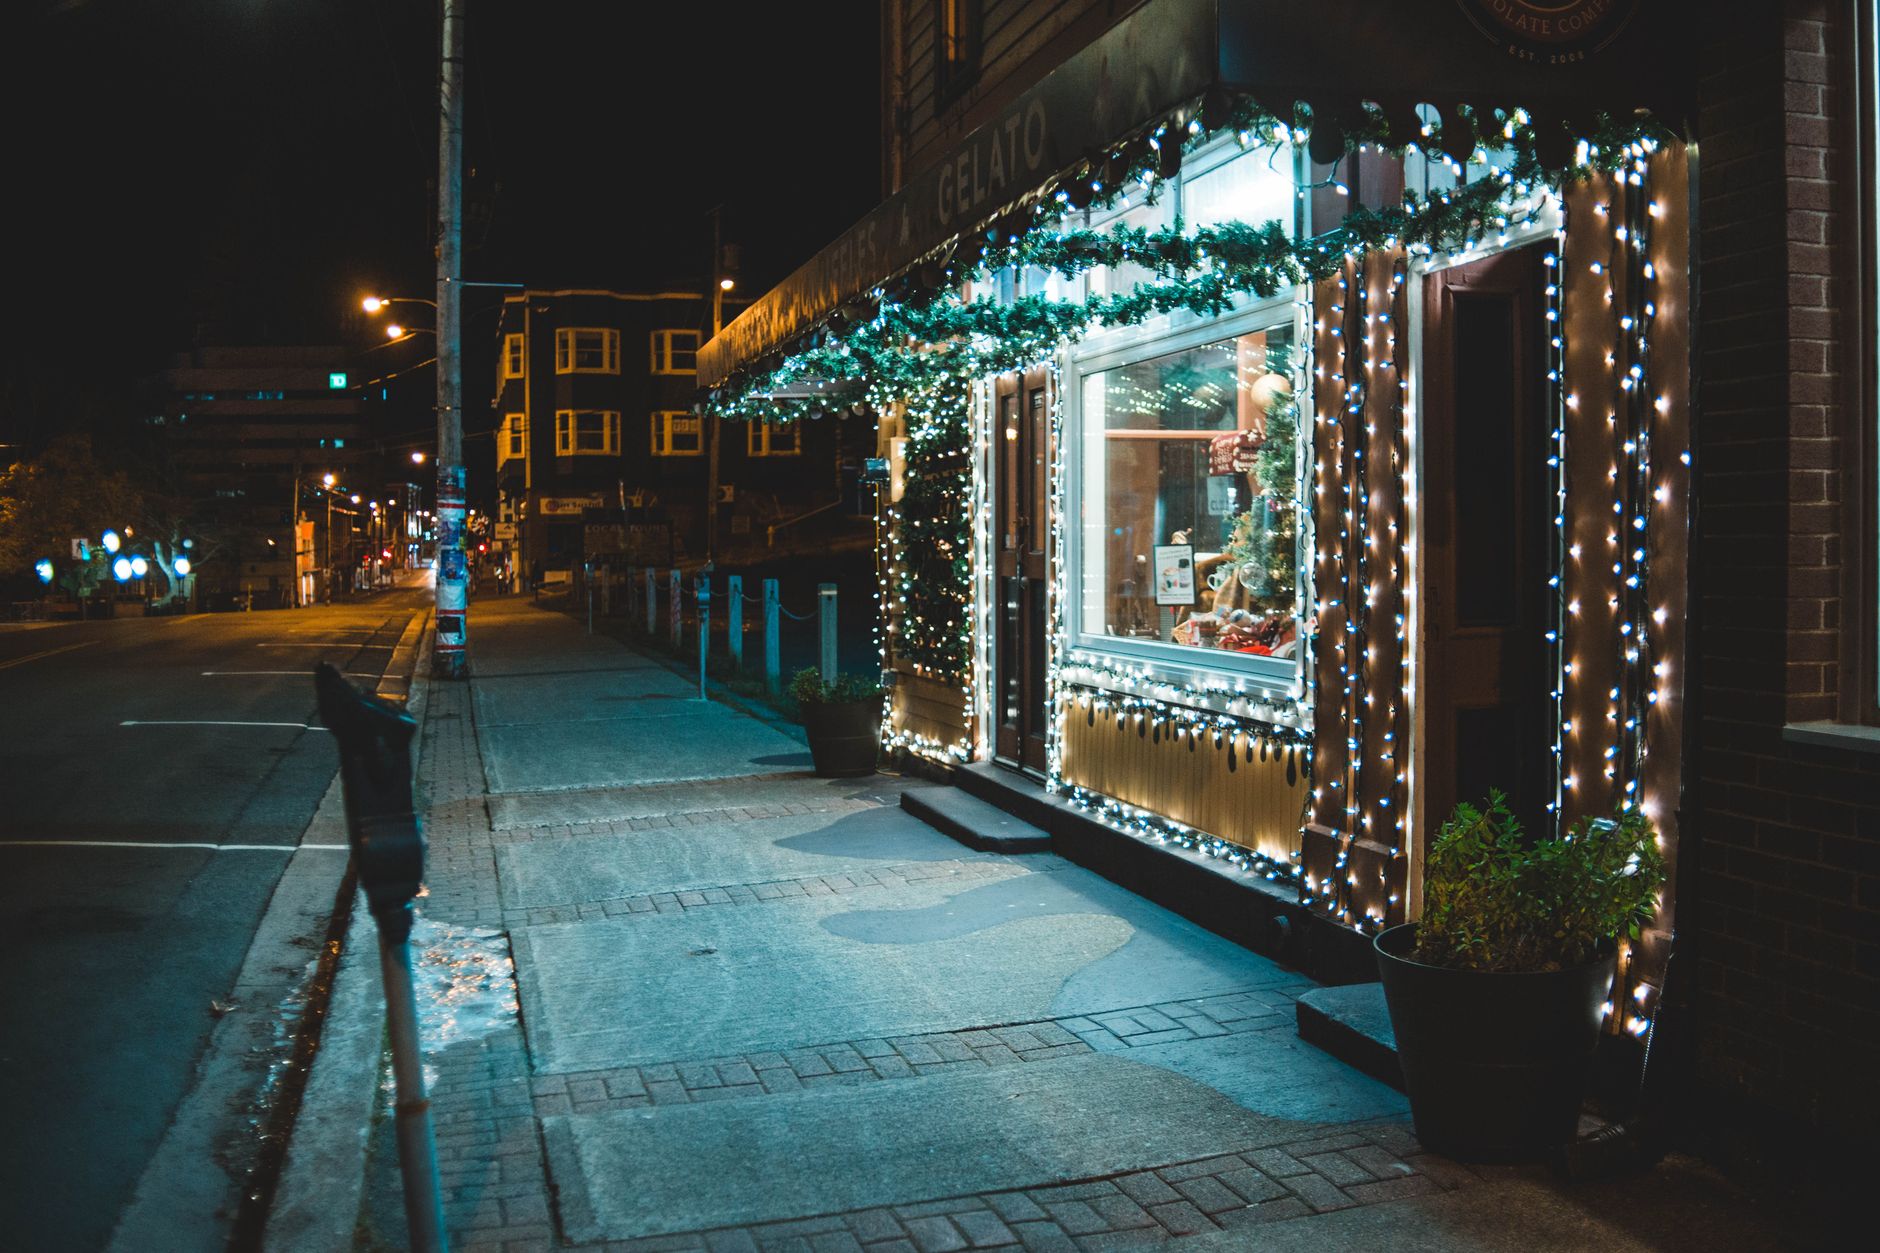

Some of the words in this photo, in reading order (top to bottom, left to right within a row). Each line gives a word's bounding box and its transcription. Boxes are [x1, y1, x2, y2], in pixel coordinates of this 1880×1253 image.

[1490, 0, 1551, 35] OLATE
[1558, 0, 1610, 34] COMP
[1508, 44, 1541, 63] EST.
[937, 97, 1047, 227] GELATO
